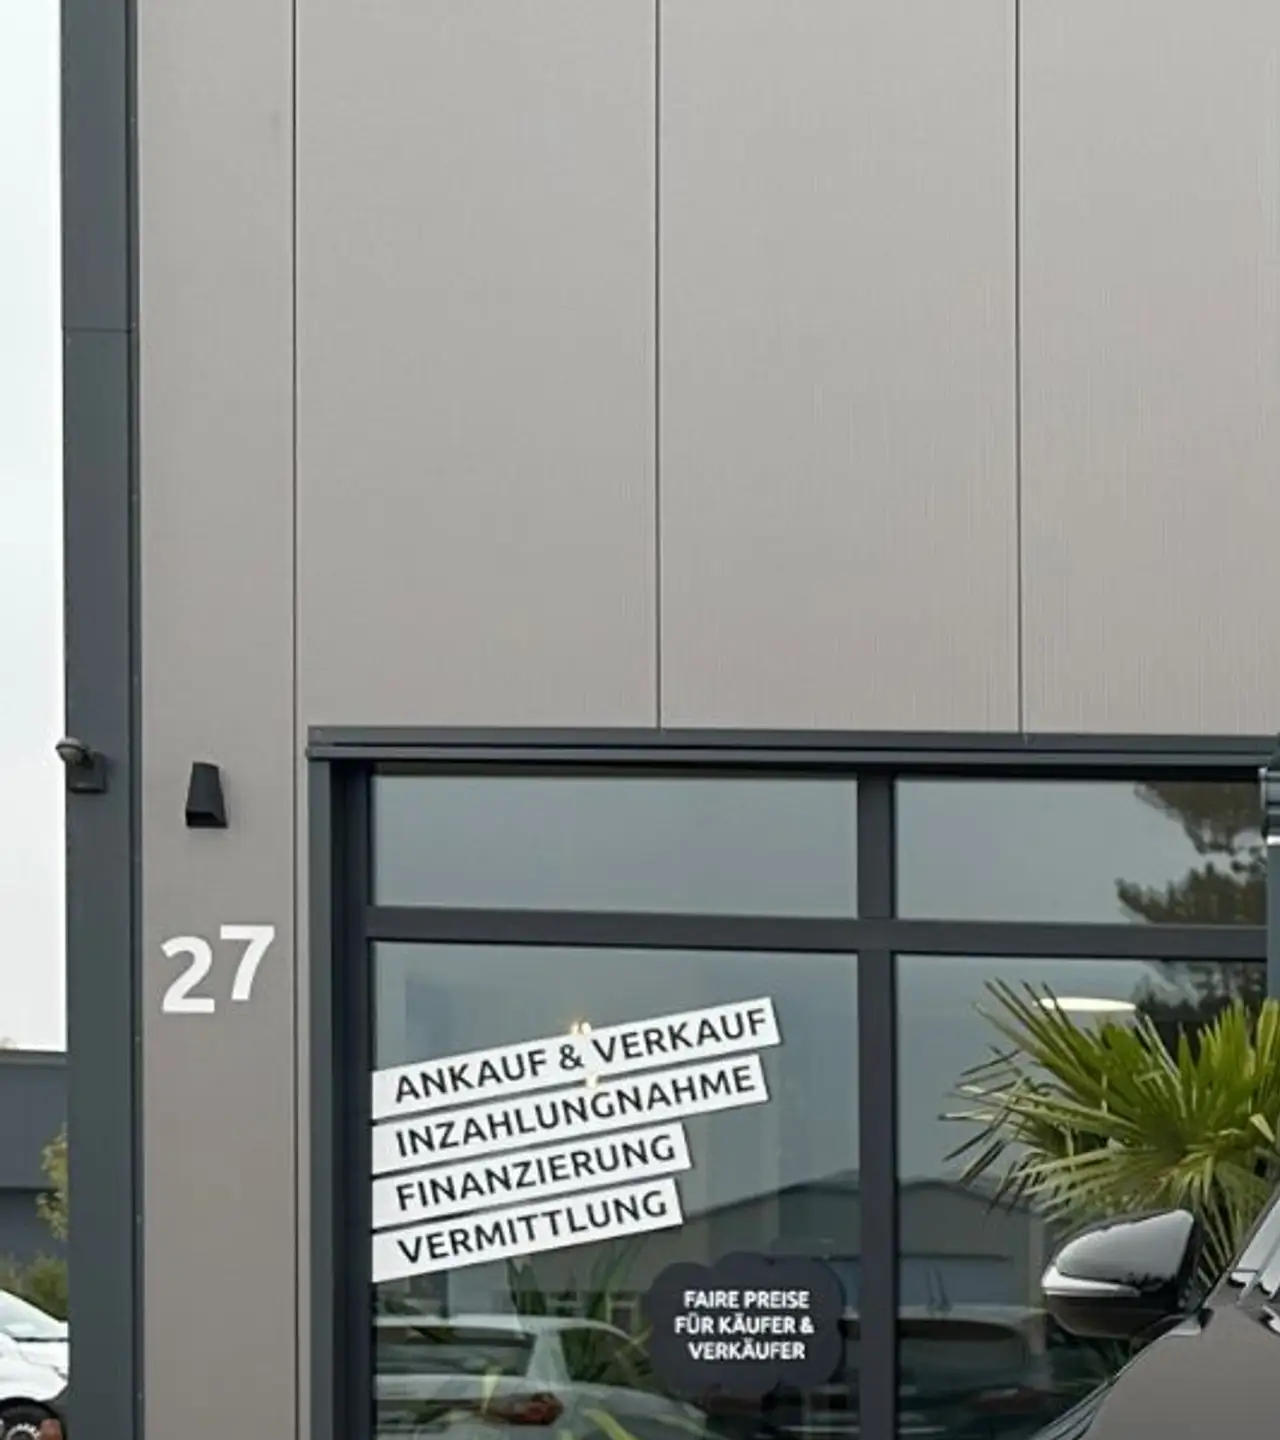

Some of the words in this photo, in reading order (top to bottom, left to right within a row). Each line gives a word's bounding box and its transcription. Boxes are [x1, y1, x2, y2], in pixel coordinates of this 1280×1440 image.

[161, 924, 275, 1014] 27
[395, 1048, 549, 1104] ANKAUF
[559, 1045, 584, 1071] &
[593, 1008, 767, 1064] VERKAUF
[397, 1065, 755, 1158] INZAHLUNGNAHME
[397, 1134, 676, 1211] FINANZIERUNG
[397, 1190, 668, 1265] VERMITTLUNG
[674, 1311, 714, 1334] FÜR
[719, 1312, 796, 1334] KÄUFER
[800, 1316, 815, 1334] &
[684, 1290, 740, 1308] FAIRE
[744, 1290, 810, 1309] PREISE
[688, 1336, 806, 1360] VERKÄUFER
